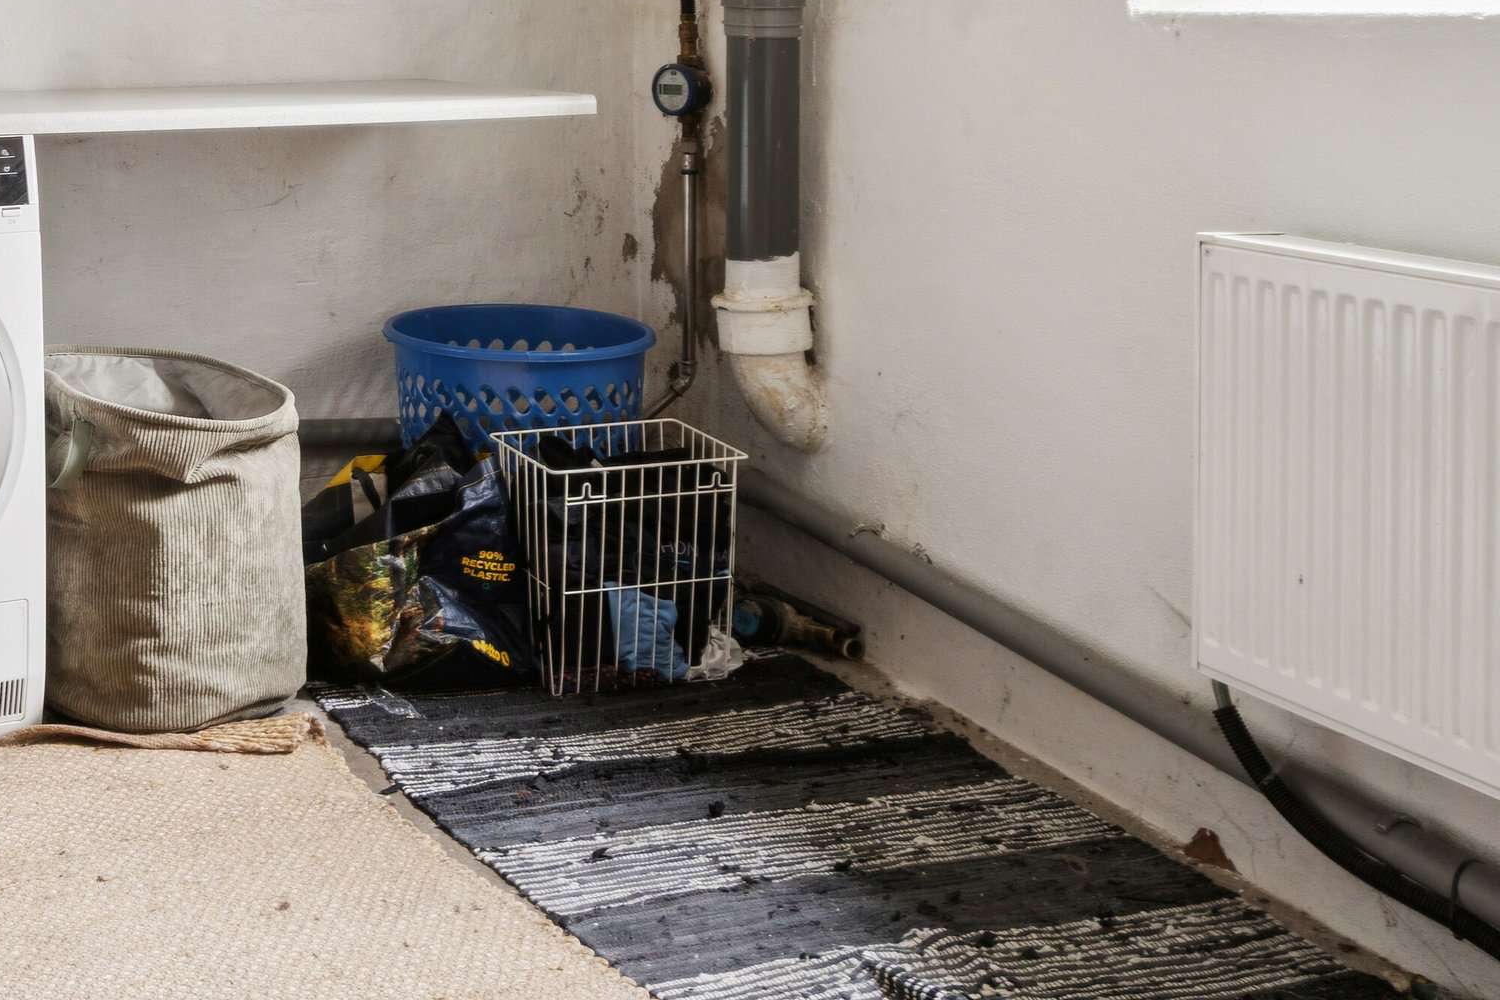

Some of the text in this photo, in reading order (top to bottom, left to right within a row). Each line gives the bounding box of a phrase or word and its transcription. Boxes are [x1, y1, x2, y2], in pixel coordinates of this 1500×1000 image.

[479, 550, 504, 561] 90%
[461, 556, 516, 572] RECYCLED
[463, 567, 511, 582] PLASTIC.
